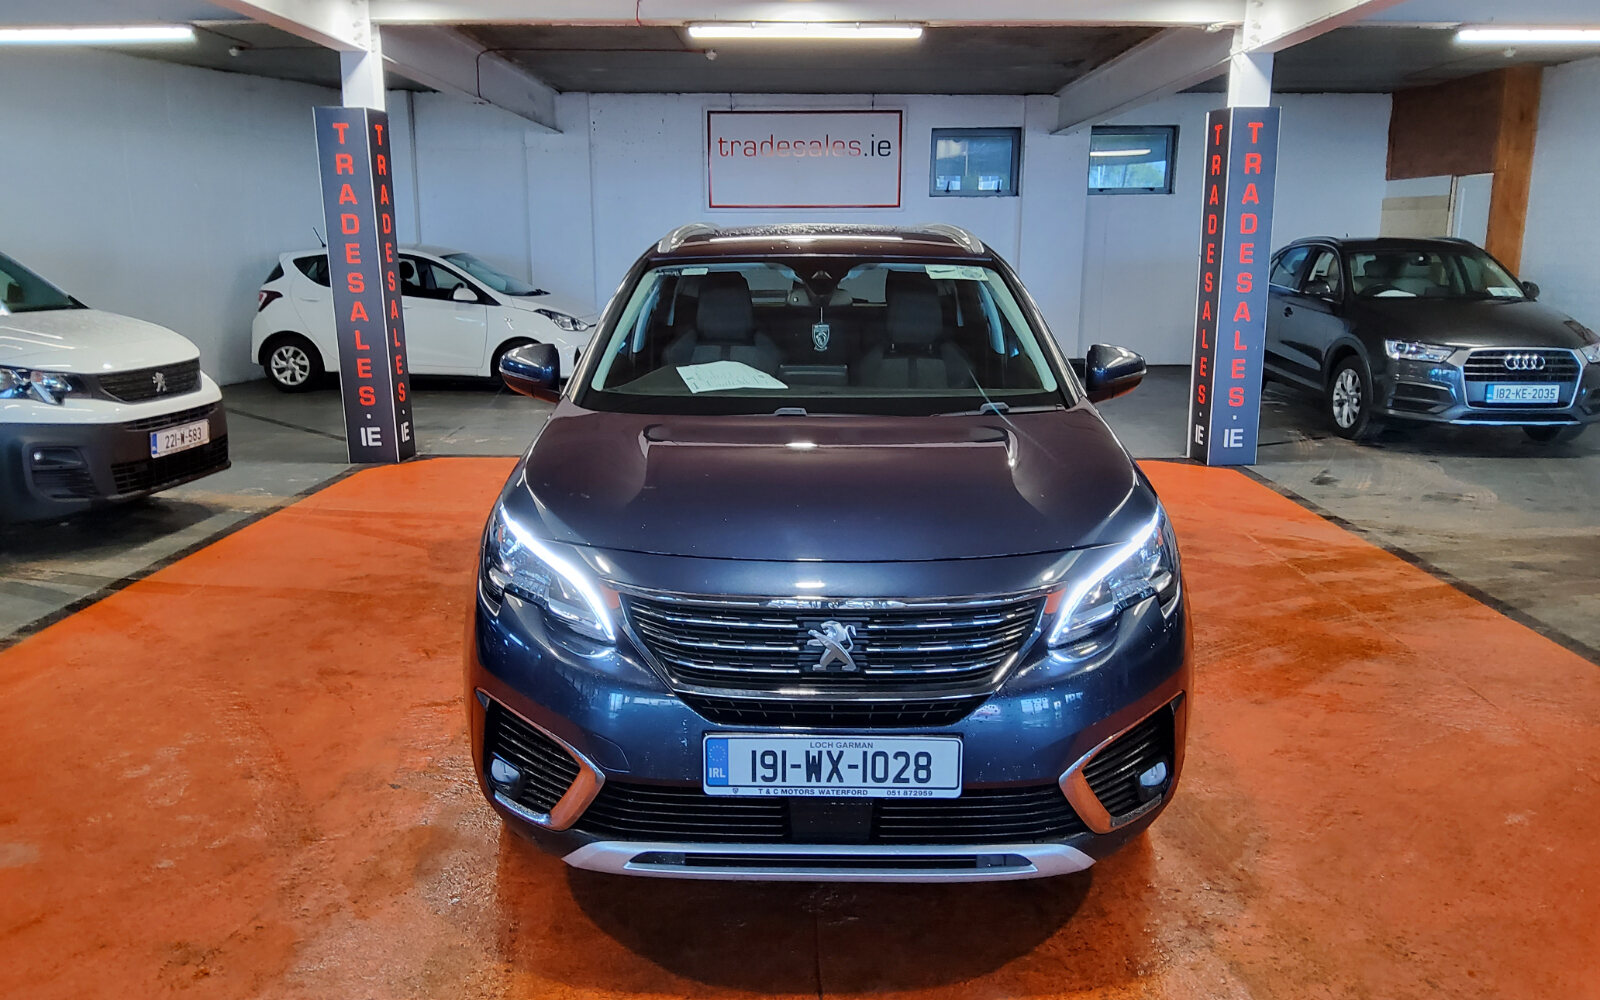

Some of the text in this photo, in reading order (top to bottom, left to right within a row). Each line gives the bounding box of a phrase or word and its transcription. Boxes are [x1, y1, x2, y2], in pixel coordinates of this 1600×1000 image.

[718, 134, 891, 157] tradesales.ie
[1496, 388, 1556, 399] 182-KE-2035
[709, 767, 727, 778] IRL
[751, 750, 932, 784] 191-WX-1028
[780, 788, 816, 796] MOTORS
